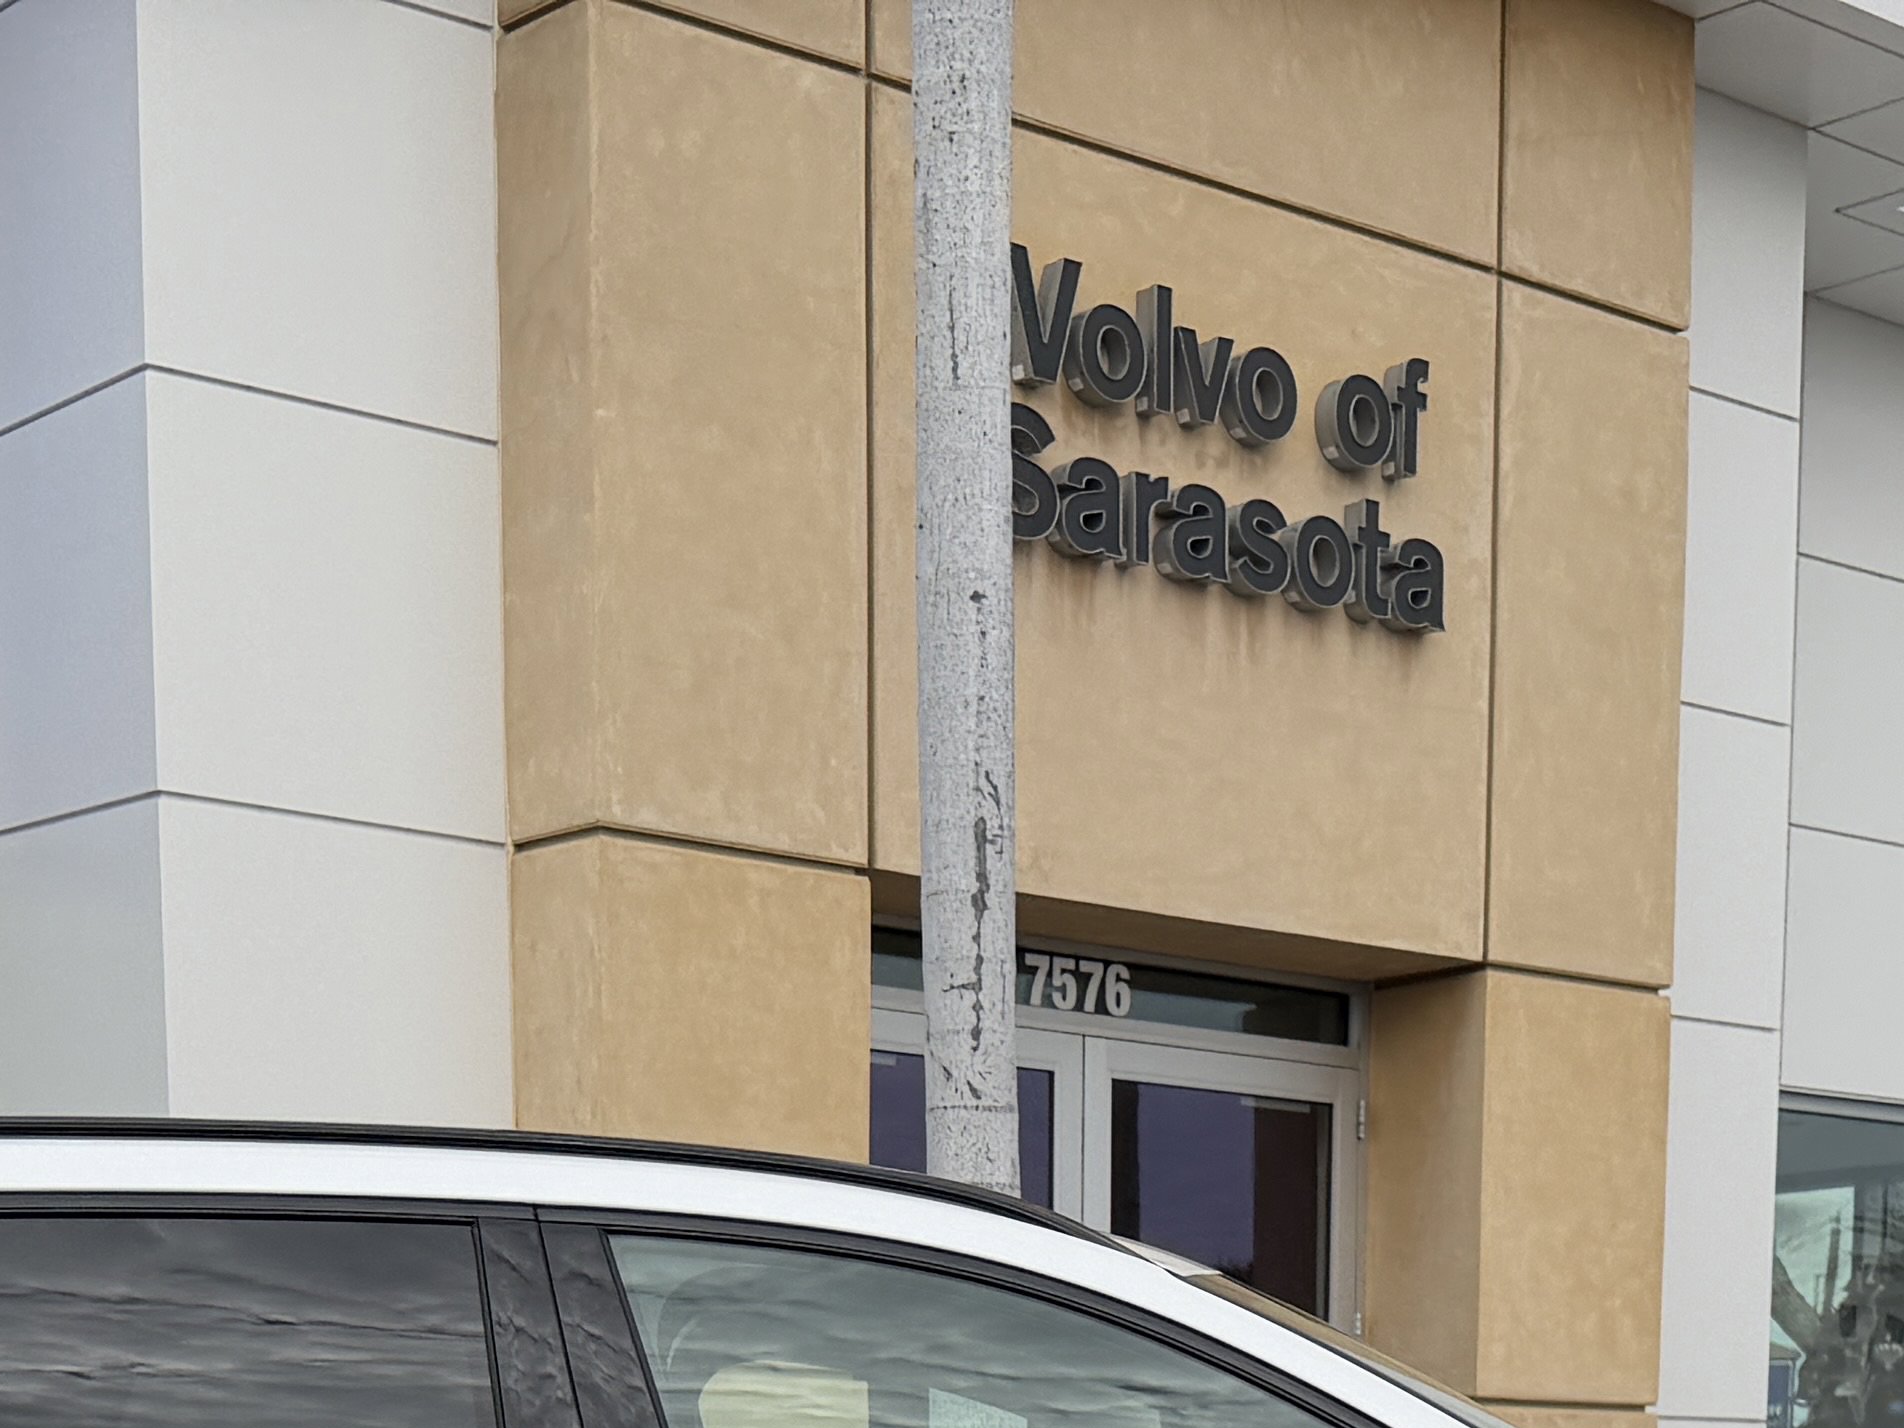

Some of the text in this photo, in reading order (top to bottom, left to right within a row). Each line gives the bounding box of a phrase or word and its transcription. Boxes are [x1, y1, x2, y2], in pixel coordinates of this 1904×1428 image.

[1010, 242, 1430, 484] Volvo of
[1010, 402, 1447, 635] Sarasota
[1023, 953, 1132, 1018] 7576
